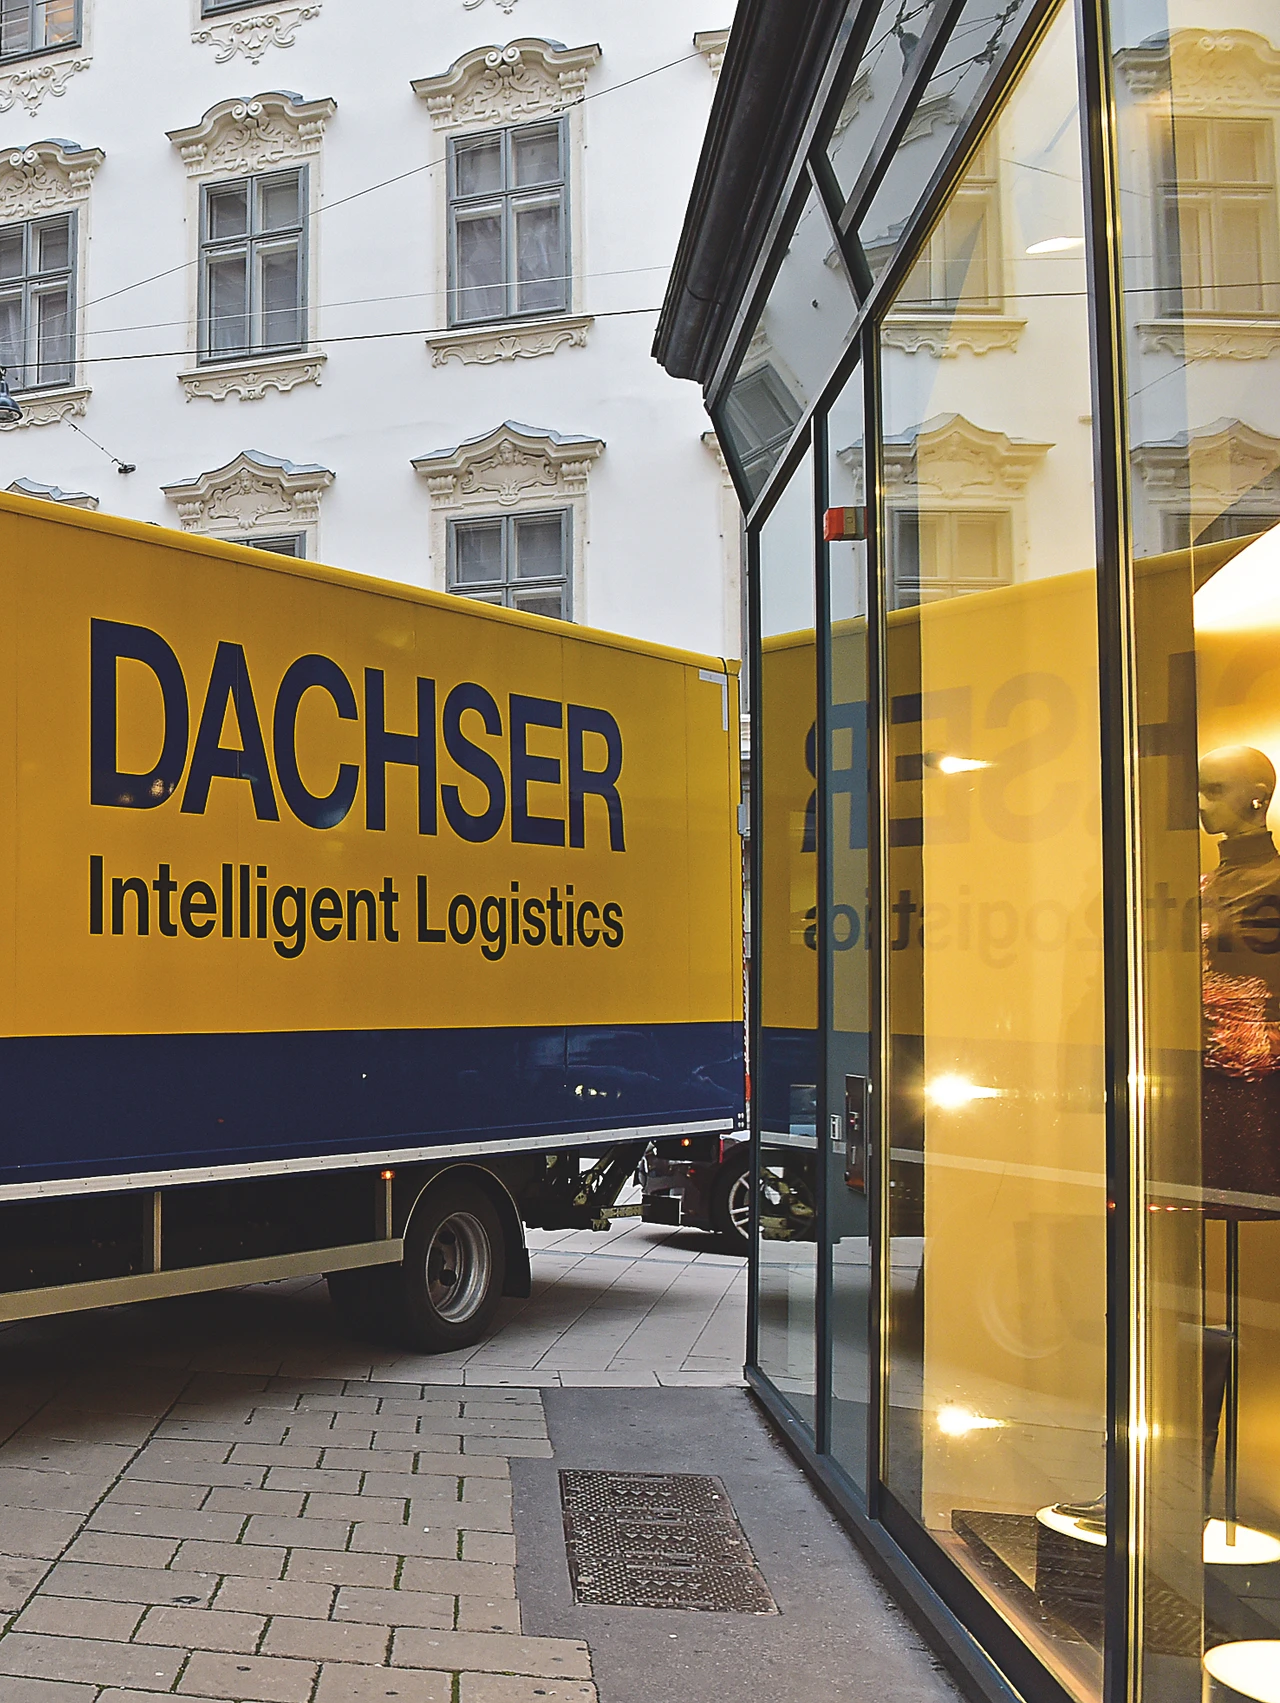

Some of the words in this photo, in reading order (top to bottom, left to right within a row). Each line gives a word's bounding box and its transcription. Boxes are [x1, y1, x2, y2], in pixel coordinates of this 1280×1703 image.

[90, 617, 626, 853] DACHSER
[89, 855, 399, 959] Intelligent
[417, 874, 625, 961] Logistics
